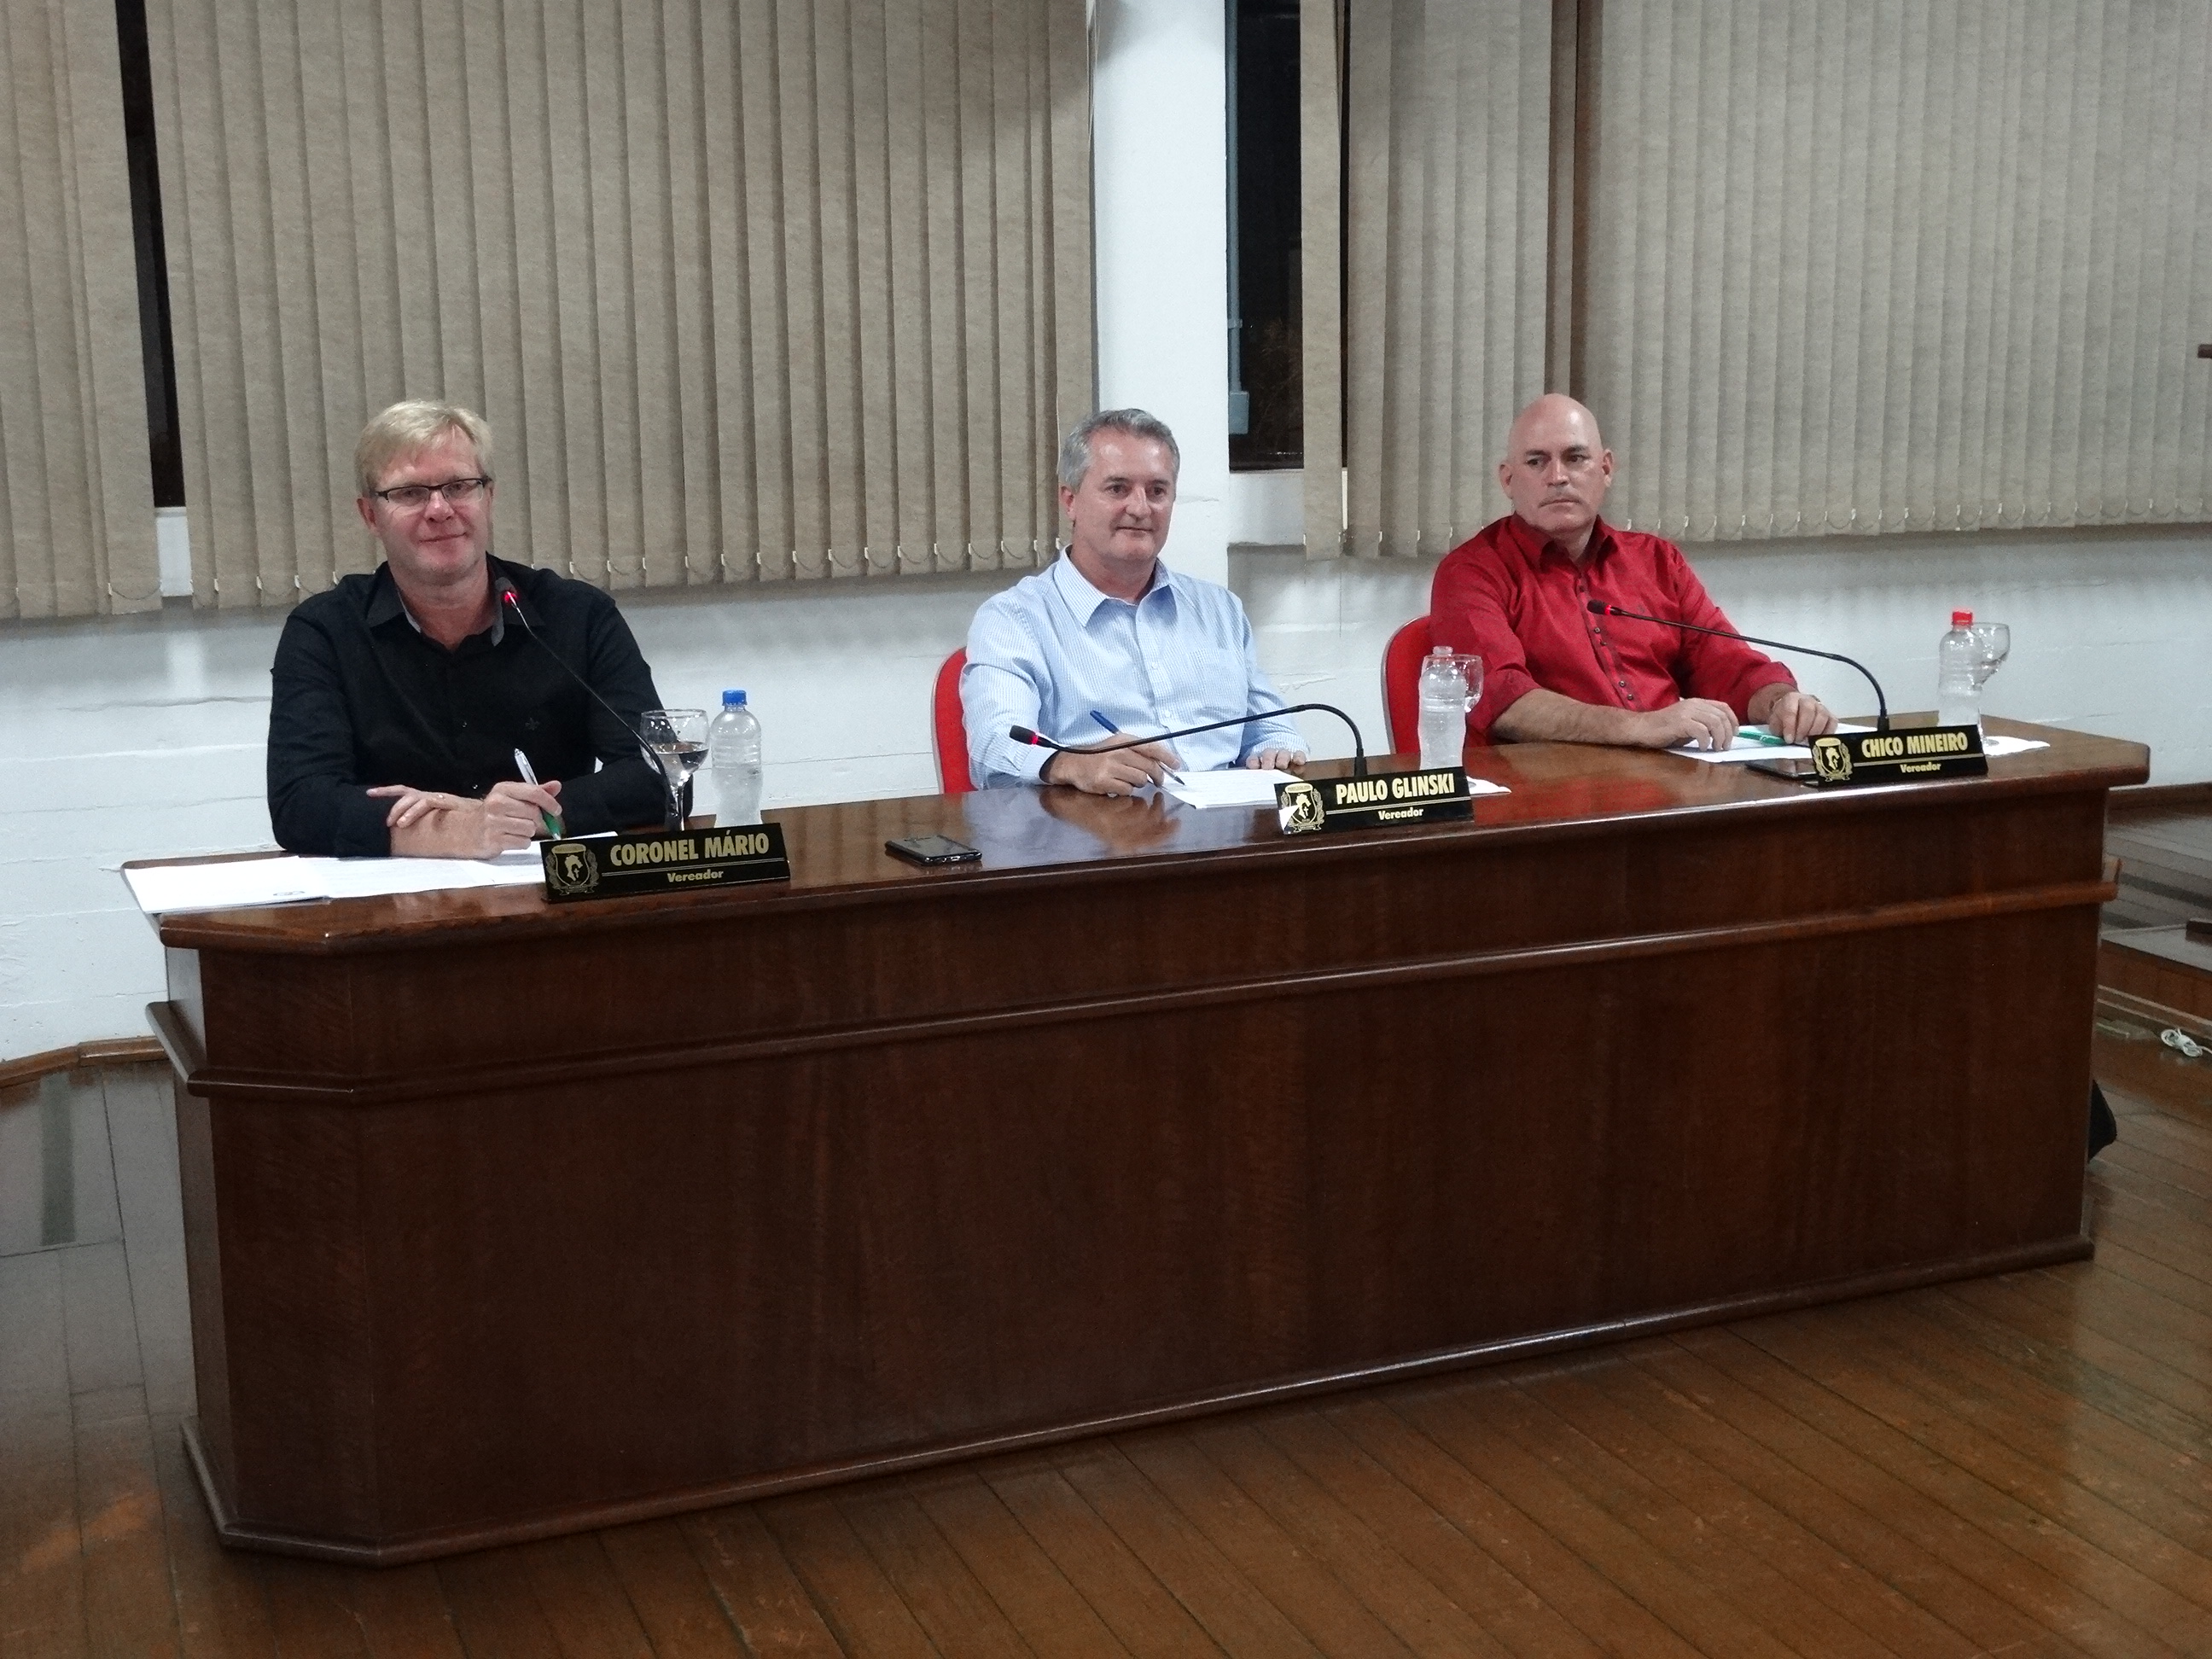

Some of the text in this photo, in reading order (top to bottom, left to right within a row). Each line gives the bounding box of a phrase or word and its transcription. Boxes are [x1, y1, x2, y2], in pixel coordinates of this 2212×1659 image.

[1861, 731, 1969, 759] CHICO MINEIRO
[1900, 762, 1941, 773] Vereador
[1336, 773, 1455, 805] PAULO GLINSKI
[1378, 807, 1424, 821] Vereador
[610, 830, 769, 866] CORONEL MÁRIO
[667, 870, 724, 883] Vereador
